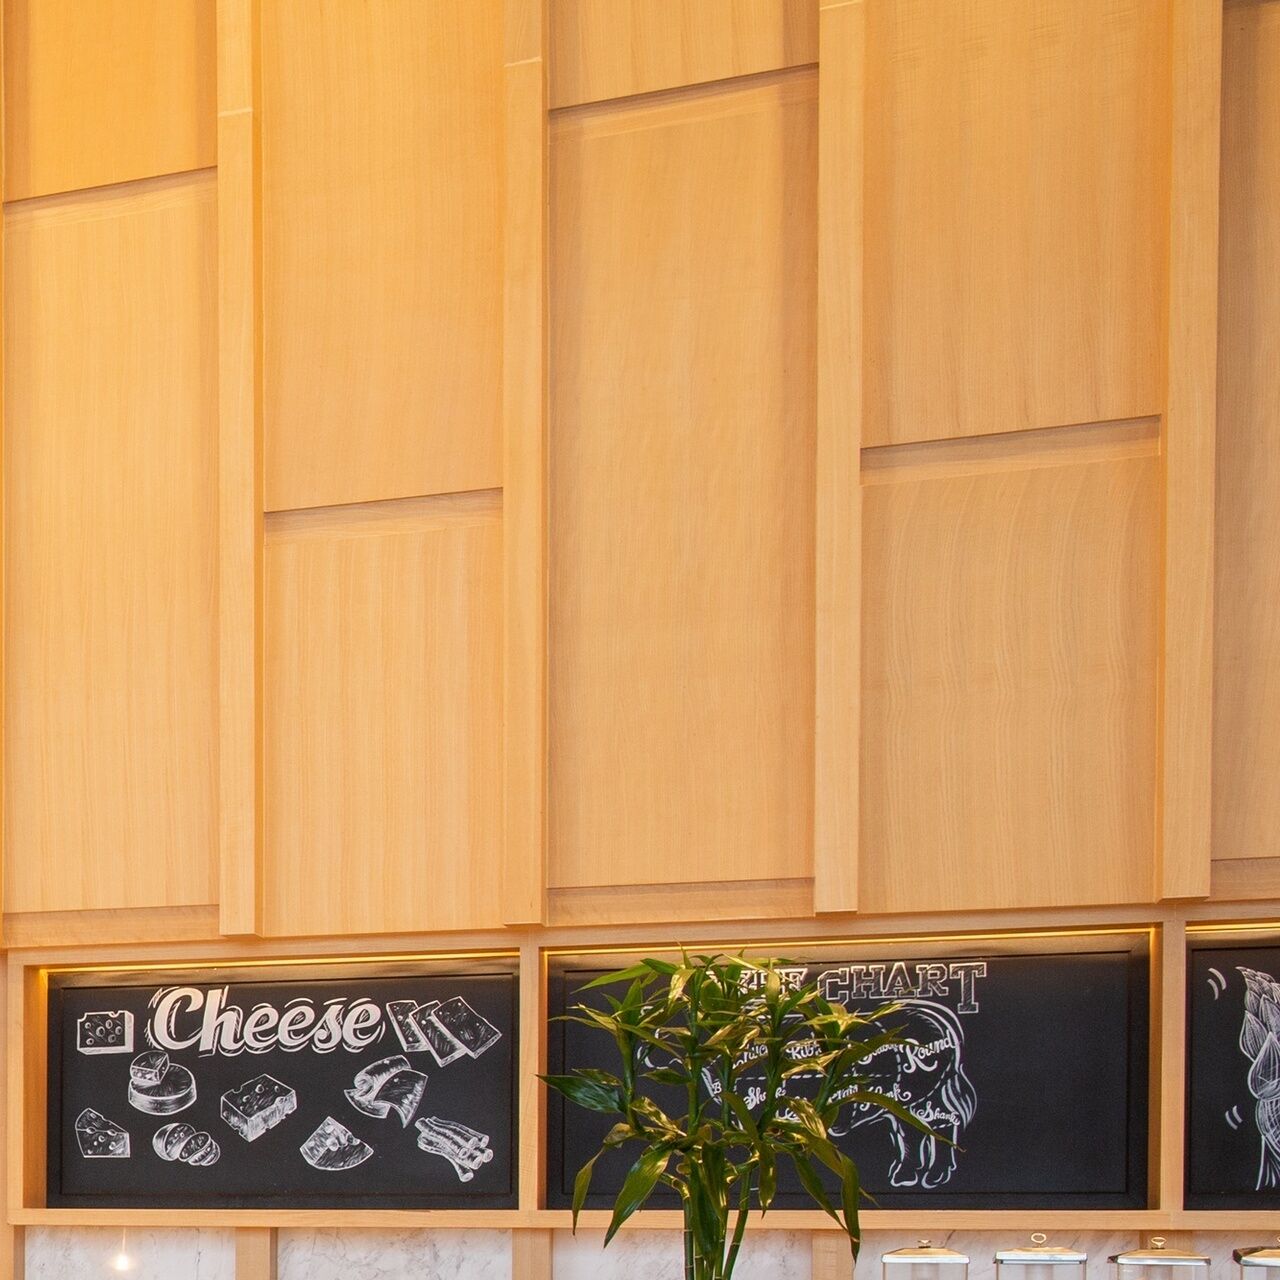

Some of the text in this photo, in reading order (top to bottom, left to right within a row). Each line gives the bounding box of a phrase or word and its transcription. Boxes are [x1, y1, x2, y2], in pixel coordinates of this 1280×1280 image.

[816, 961, 987, 1014] CHART
[148, 986, 385, 1056] Cheese
[902, 1030, 956, 1073] Round
